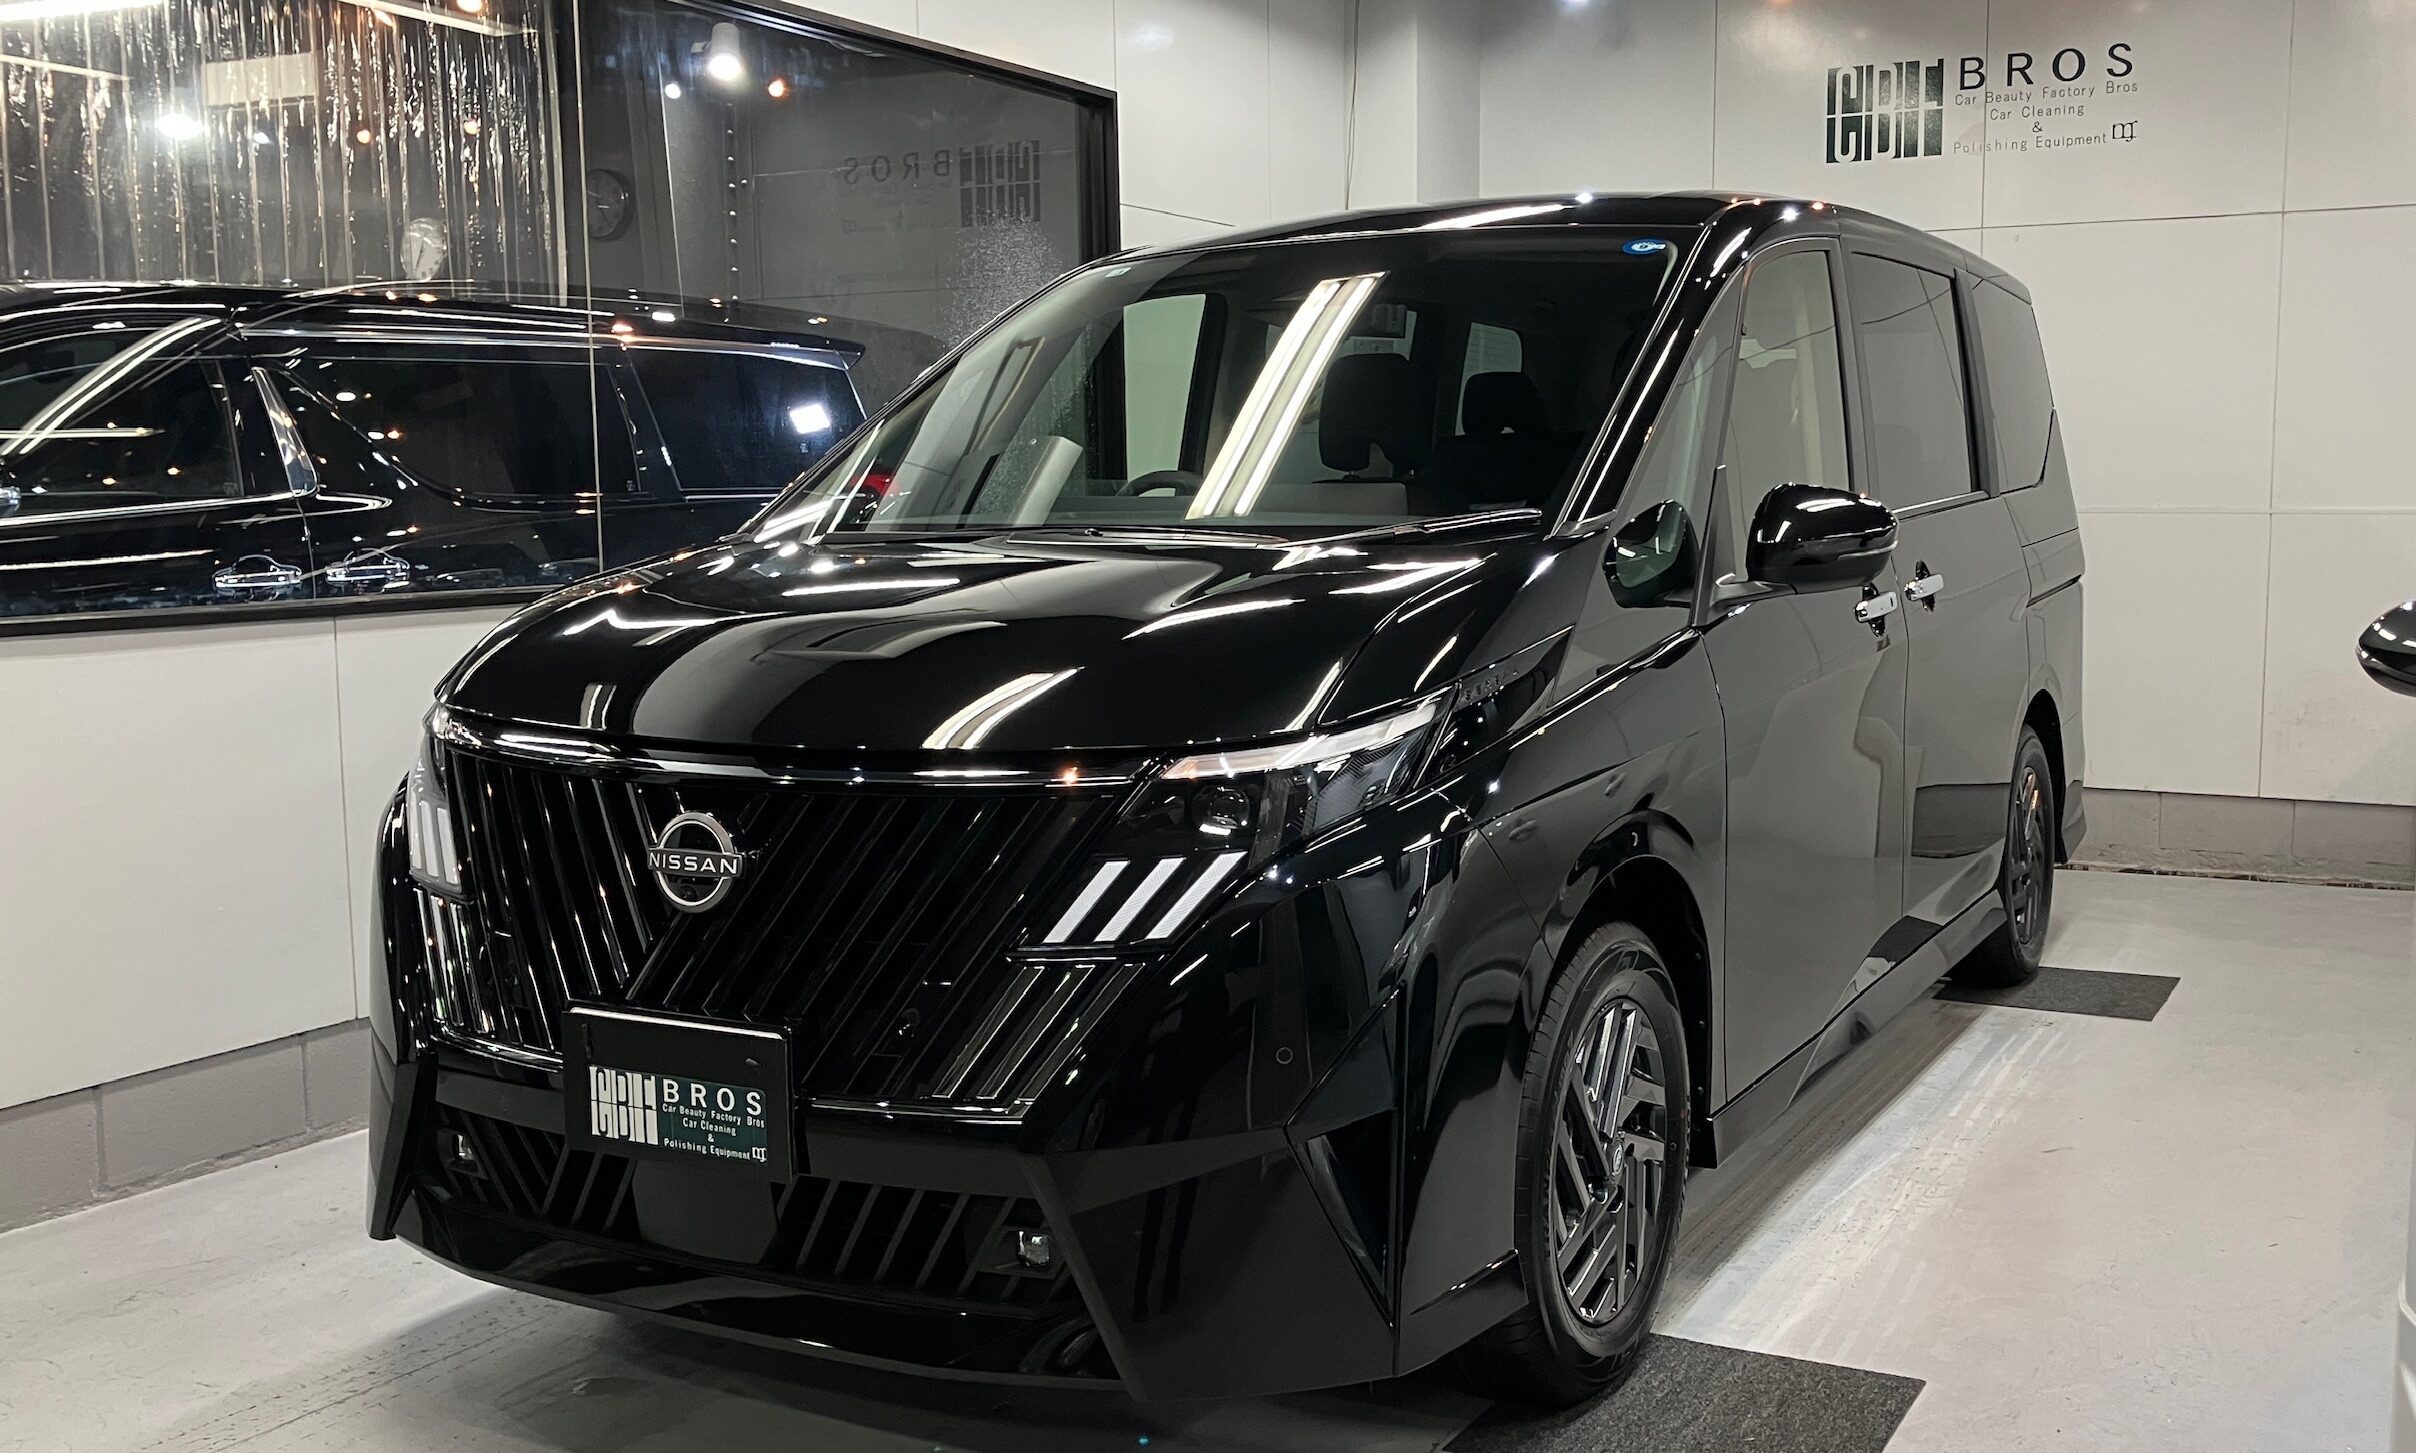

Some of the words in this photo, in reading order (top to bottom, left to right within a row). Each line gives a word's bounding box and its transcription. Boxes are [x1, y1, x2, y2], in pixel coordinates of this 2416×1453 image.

[1959, 43, 2133, 91] BROS
[1954, 94, 1977, 106] Car
[1985, 91, 2033, 104] Beauty
[2042, 86, 2096, 99] Factory
[2105, 80, 2139, 94] Bros
[1989, 108, 2012, 120] Car
[2021, 104, 2085, 118] Cleaning
[2032, 121, 2044, 133] &
[1953, 140, 2028, 154] Polishing
[2035, 133, 2107, 150] Equipment
[649, 852, 738, 874] NISSAN
[662, 1078, 762, 1116] BROS
[662, 1103, 677, 1113] Car
[679, 1105, 707, 1119] Beauty
[711, 1110, 742, 1126] Factory
[746, 1115, 765, 1128] Bros
[682, 1117, 698, 1129] Car
[700, 1120, 737, 1137] Cleaning
[707, 1132, 715, 1143] &
[663, 1138, 707, 1154] Polishing
[710, 1145, 751, 1160] Equipment
